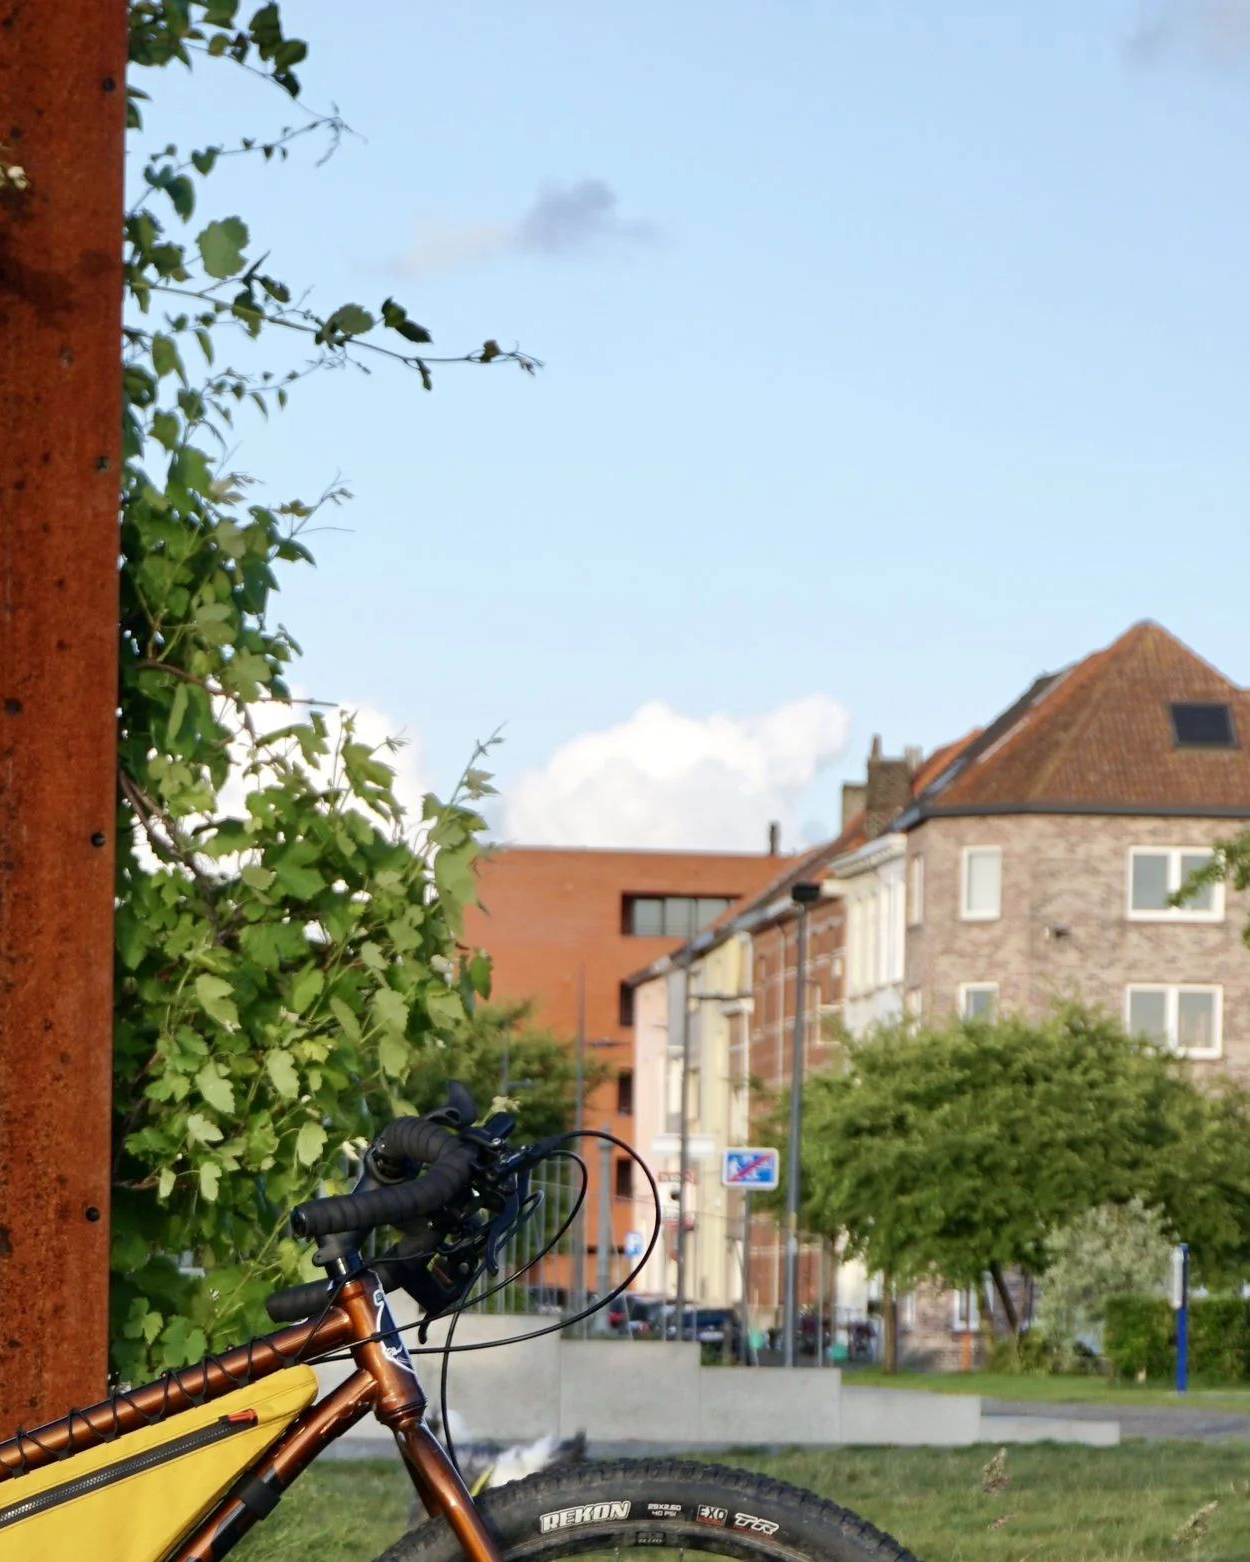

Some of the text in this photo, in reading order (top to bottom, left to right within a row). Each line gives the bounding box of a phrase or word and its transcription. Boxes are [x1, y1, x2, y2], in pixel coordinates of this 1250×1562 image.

[540, 1500, 631, 1534] REKON
[698, 1505, 727, 1521] EXO
[735, 1512, 779, 1535] TR
